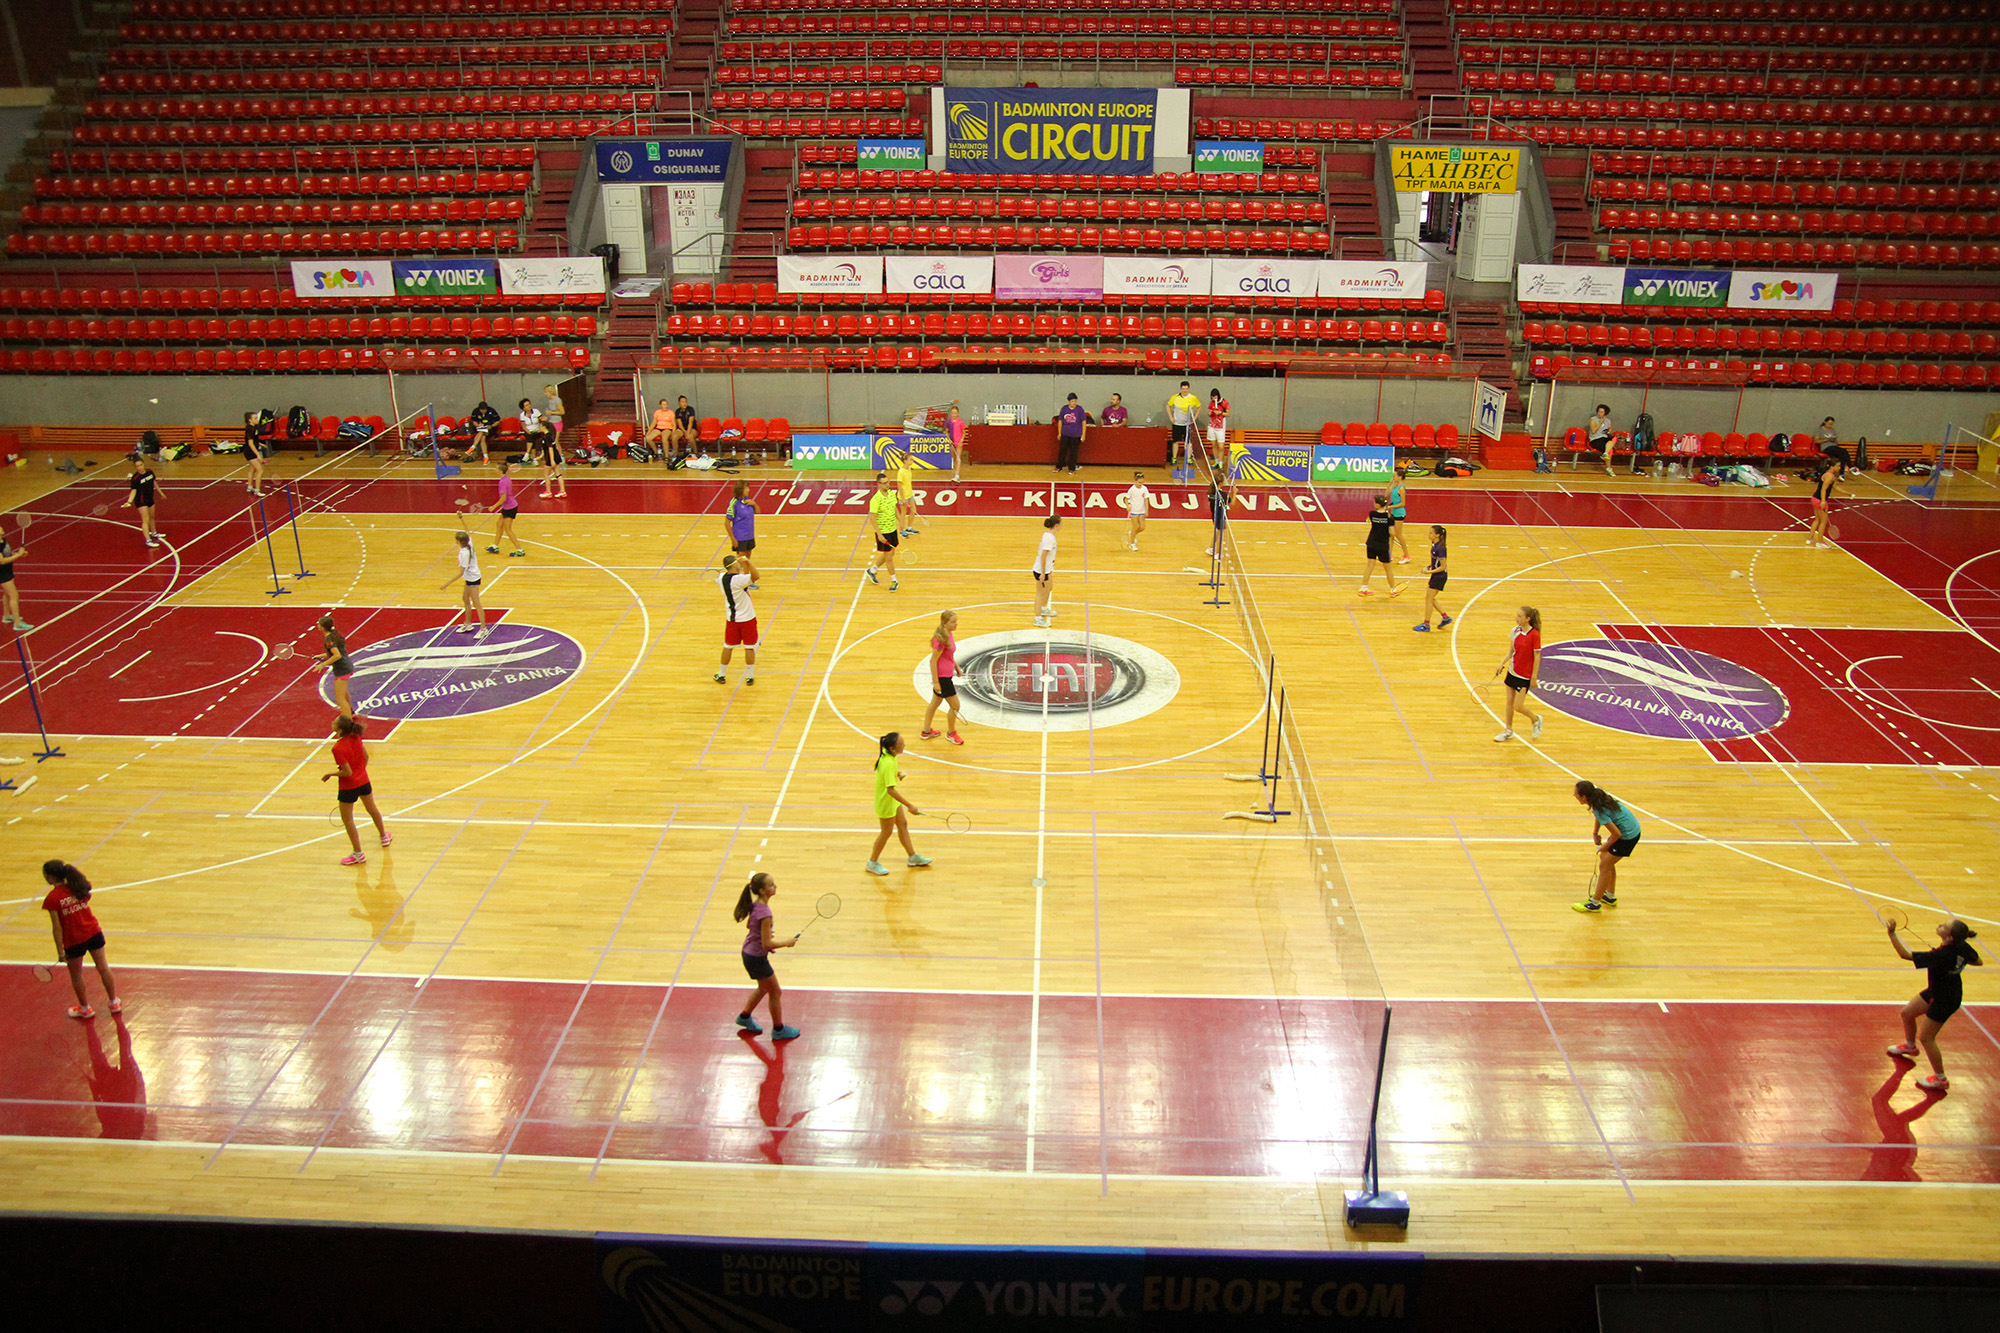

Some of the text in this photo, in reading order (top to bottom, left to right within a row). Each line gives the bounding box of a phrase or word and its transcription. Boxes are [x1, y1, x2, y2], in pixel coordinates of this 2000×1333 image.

[1003, 102, 1153, 118] BADMINTON EUROPE
[1002, 122, 1152, 161] CIRCUIT
[668, 149, 704, 157] DUNAV
[883, 147, 920, 160] YONEX
[949, 149, 988, 160] EUROPE
[1221, 149, 1259, 162] YONEX
[1401, 151, 1511, 161] НАМЕШТАЈ
[653, 165, 721, 174] OSIGURANJE
[1395, 162, 1514, 180] ДАНВЕС
[1406, 180, 1501, 190] ТРГ МАЛА ВАГА
[435, 269, 486, 286] YONEX
[1667, 279, 1719, 298] YONEX
[822, 446, 866, 460] YONEX
[910, 444, 950, 453] EUROPE
[1266, 449, 1308, 457] BADMINTON
[1266, 456, 1308, 468] EUROPE
[1344, 458, 1389, 472] YONEX
[1023, 491, 1317, 512] KRAUJVAC
[1005, 662, 1103, 692] FIAT
[357, 665, 567, 710] KOMERCIJALNA BANKA
[1536, 679, 1746, 731] KOMERCIJALNA BANKA
[721, 1253, 861, 1273] BADMINTON
[722, 1271, 861, 1302] EUROPE
[976, 1275, 1407, 1318] YONEX EUROPE.COM
